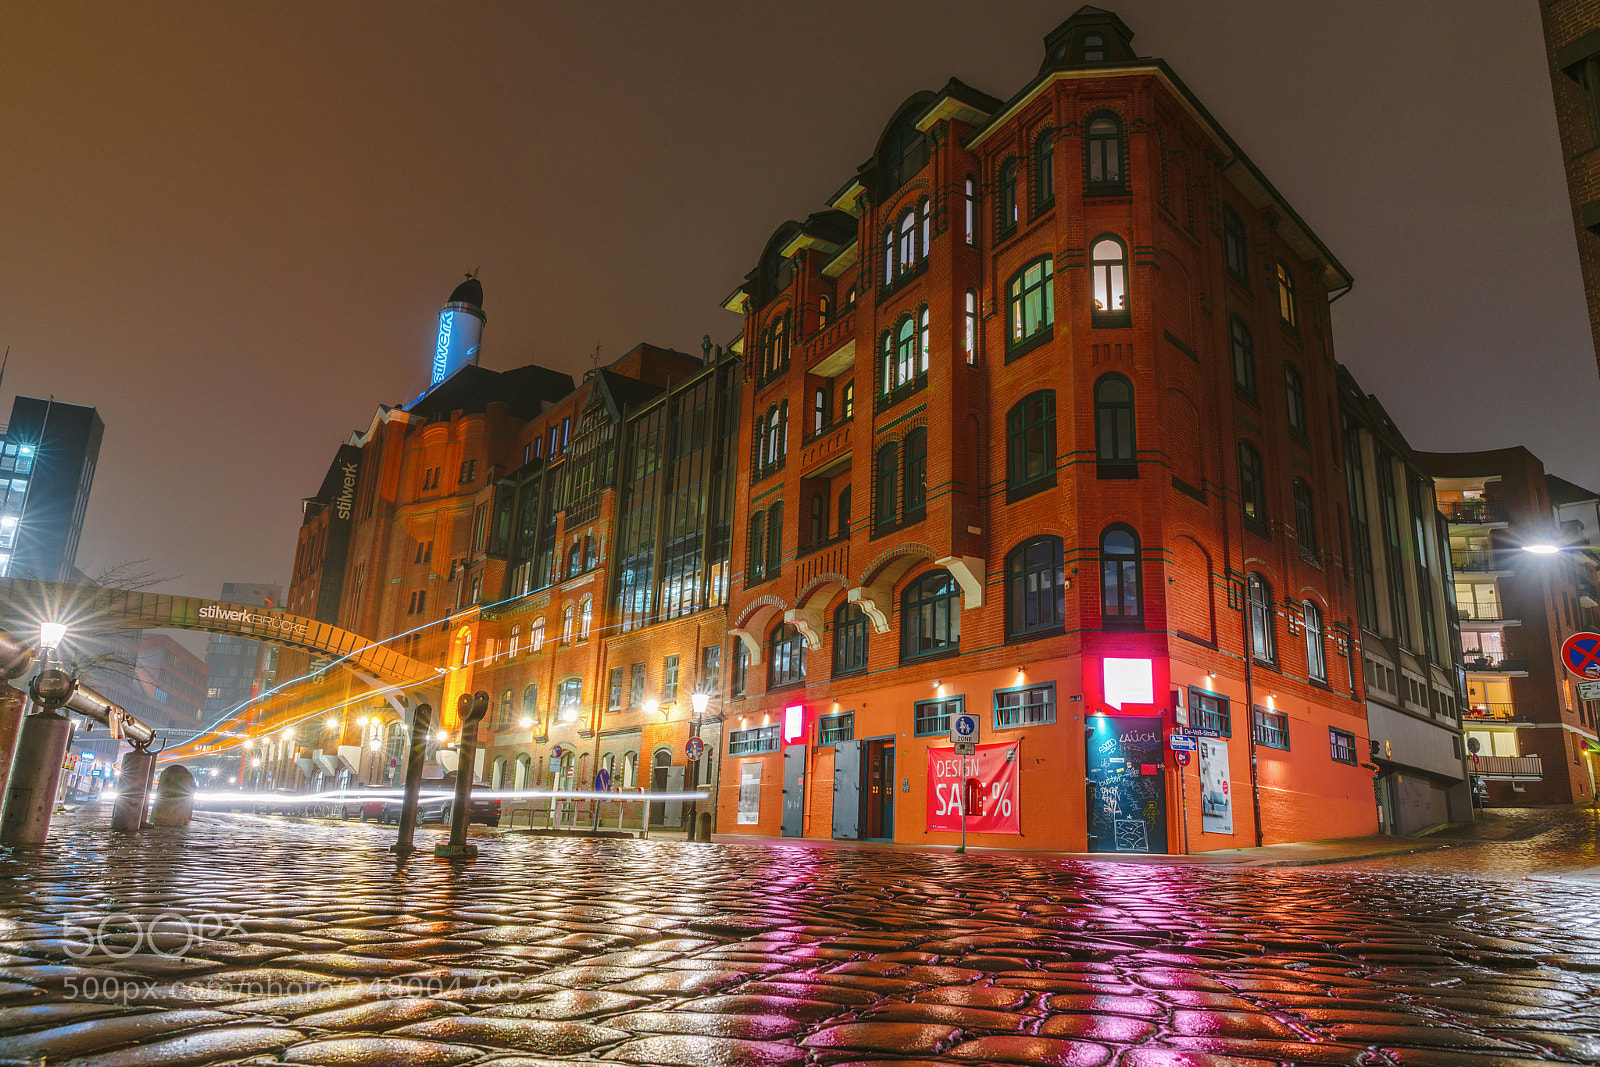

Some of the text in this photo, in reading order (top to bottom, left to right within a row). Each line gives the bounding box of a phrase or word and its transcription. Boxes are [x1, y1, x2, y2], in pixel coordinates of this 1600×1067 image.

[433, 310, 454, 383] stilwerk
[338, 462, 358, 521] stilwerk
[936, 758, 979, 778] DESIGN
[991, 781, 1012, 817] %
